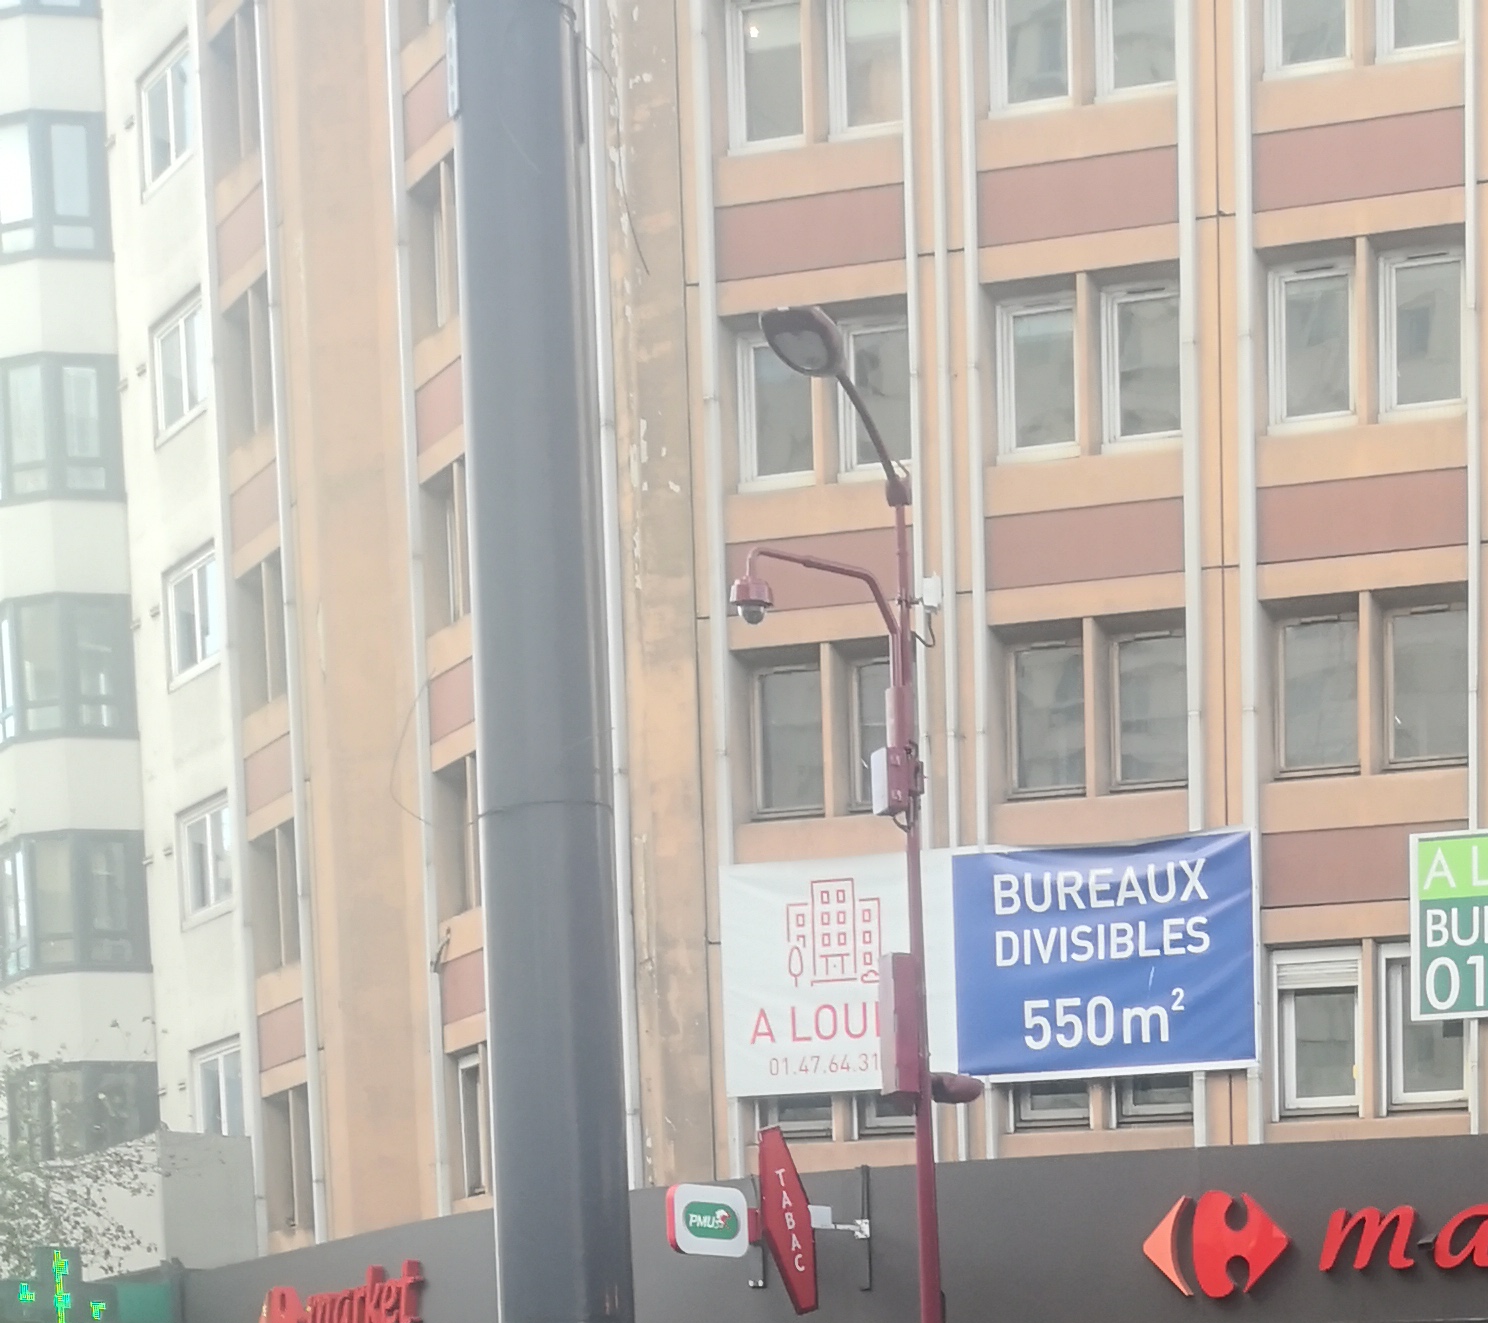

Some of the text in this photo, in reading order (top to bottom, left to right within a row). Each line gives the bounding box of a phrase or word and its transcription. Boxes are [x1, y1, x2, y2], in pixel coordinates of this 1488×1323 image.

[993, 857, 1209, 916] BUREAUX
[1423, 847, 1456, 890] A
[995, 916, 1211, 967] DIVISIBLES
[1425, 955, 1486, 1011] 01
[750, 1001, 881, 1044] A LOU
[769, 1053, 881, 1076] 01.47.64.31
[688, 1213, 716, 1229] PMU
[774, 1167, 806, 1272] TABAC
